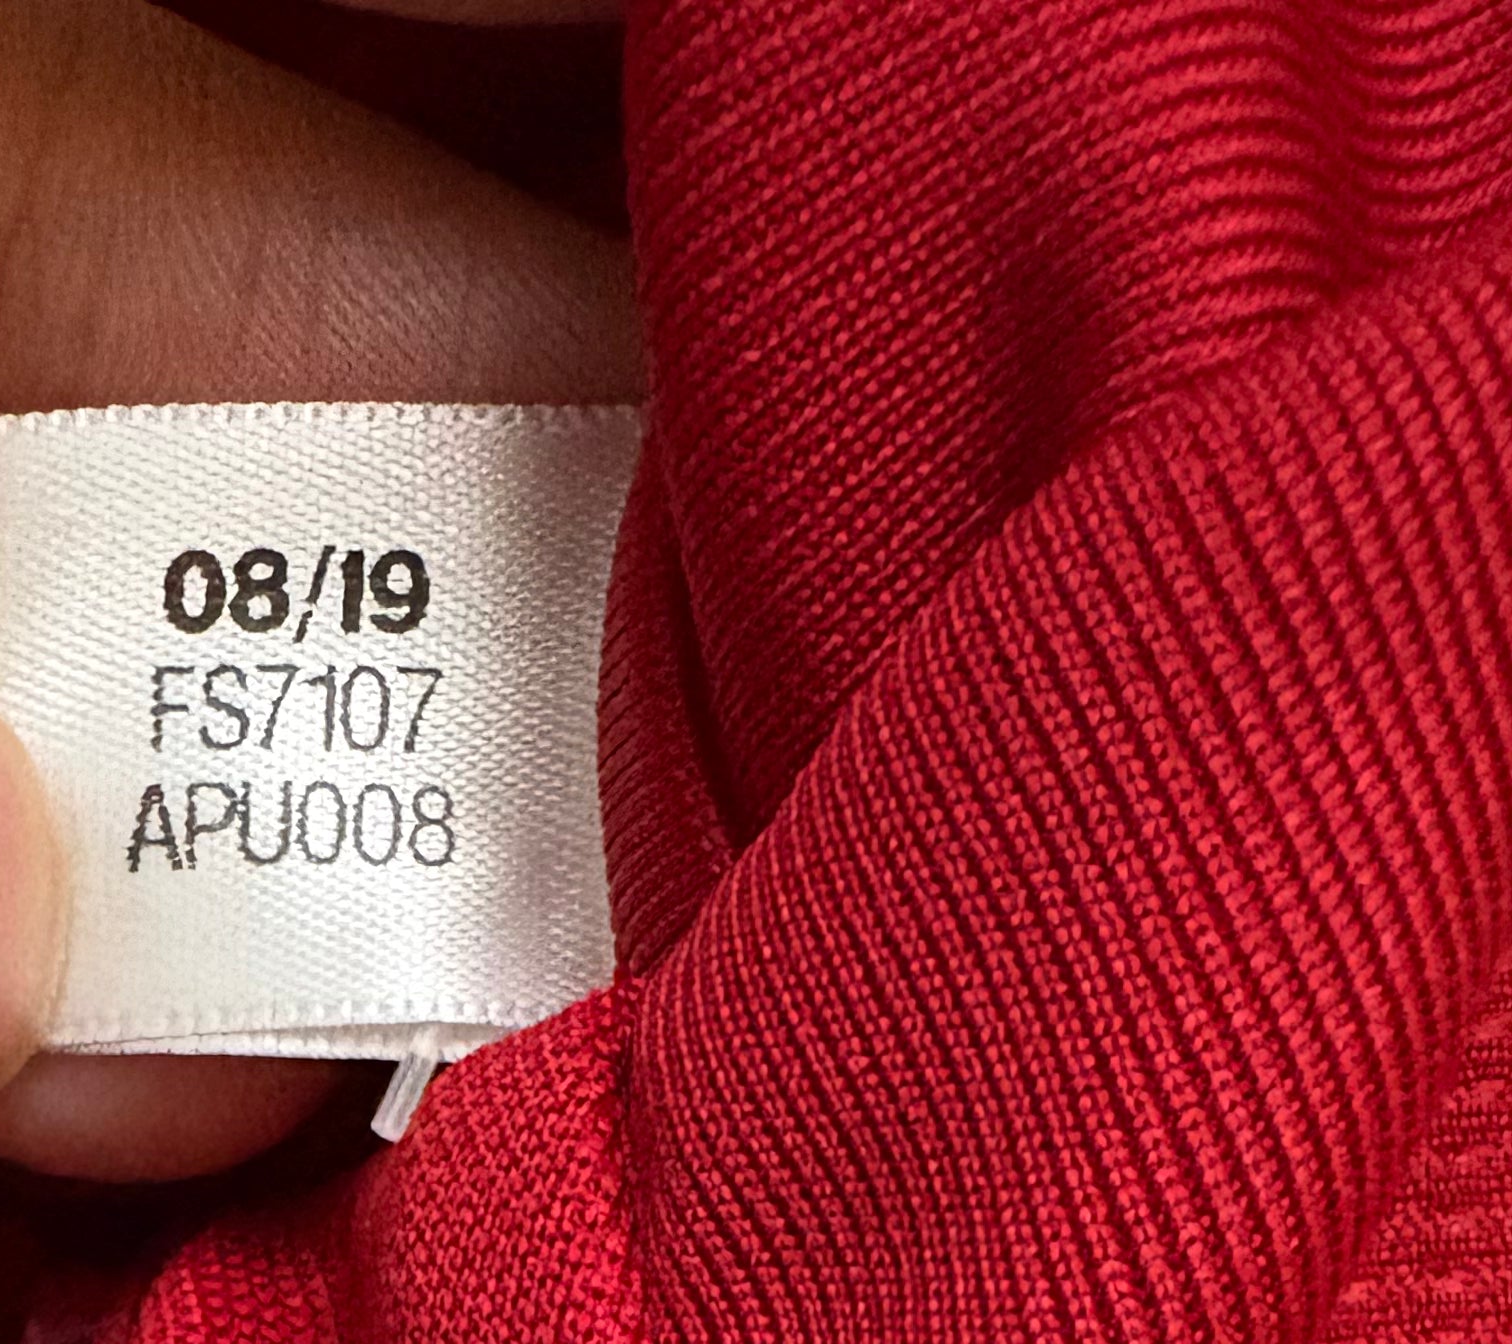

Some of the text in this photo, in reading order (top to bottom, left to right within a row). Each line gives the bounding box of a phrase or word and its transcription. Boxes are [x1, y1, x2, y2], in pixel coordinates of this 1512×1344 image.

[163, 545, 430, 642] 08/19
[150, 665, 443, 752] FS7107
[127, 780, 455, 872] APU008
